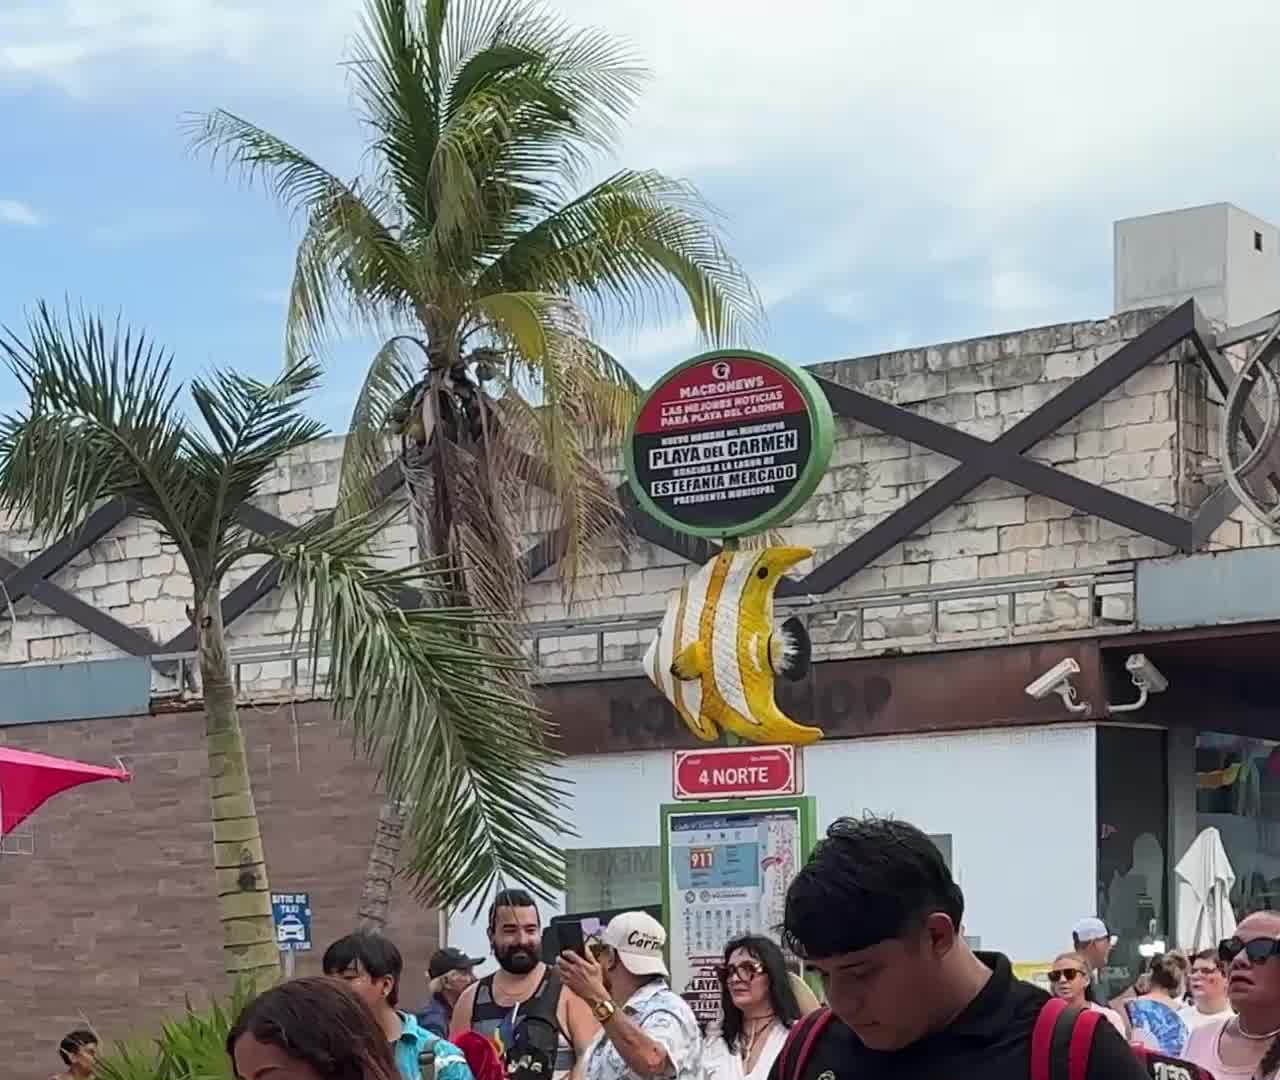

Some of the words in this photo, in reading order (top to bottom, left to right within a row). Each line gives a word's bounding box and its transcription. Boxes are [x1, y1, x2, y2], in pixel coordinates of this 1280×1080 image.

[680, 376, 764, 399] MACRONEWS
[661, 415, 689, 427] PARA
[691, 411, 722, 423] PLAYA
[744, 401, 785, 416] CARMEN
[662, 405, 682, 417] LAS
[685, 398, 732, 415] MEJORES
[735, 390, 783, 406] NOTICIAS
[652, 446, 701, 467] PLAYA
[703, 446, 724, 459] DEL
[727, 433, 795, 457] CARMEN
[728, 465, 795, 486] MERCADO
[698, 769, 710, 785] 4
[713, 766, 769, 785] NORTE
[691, 852, 713, 867] 911
